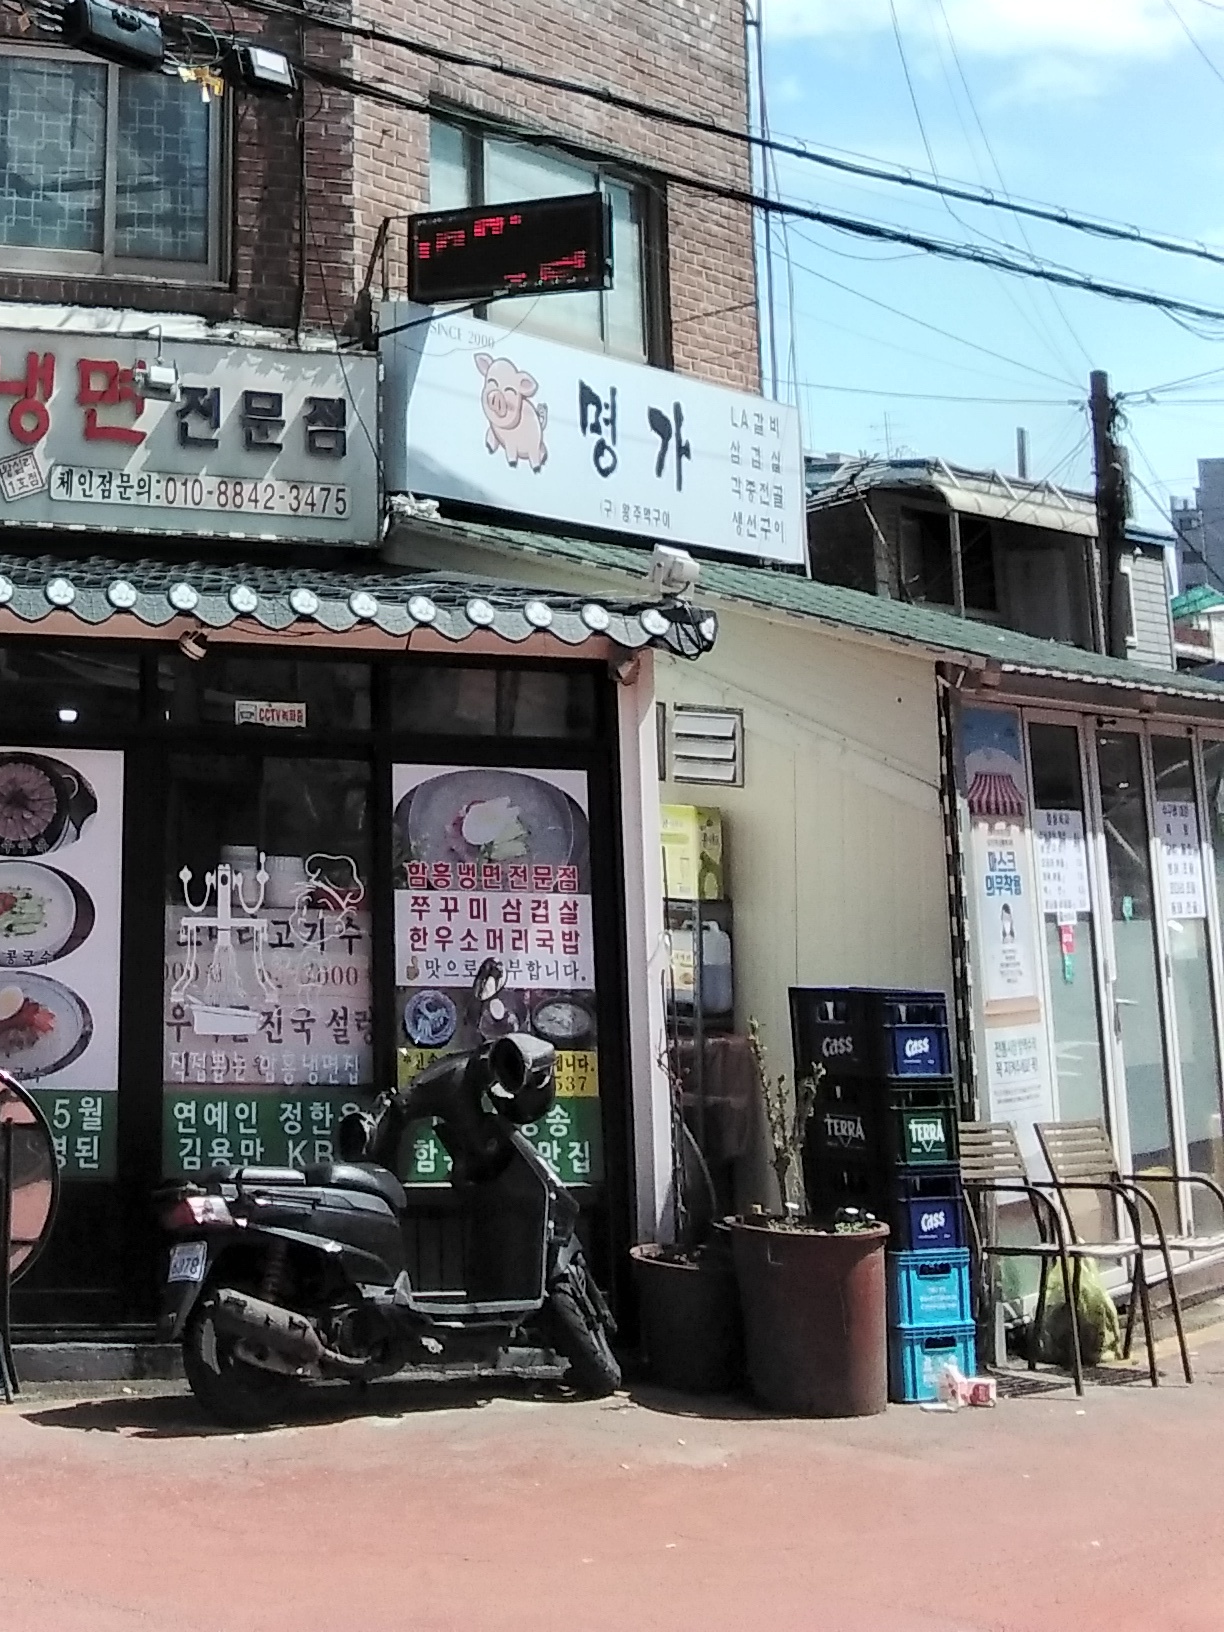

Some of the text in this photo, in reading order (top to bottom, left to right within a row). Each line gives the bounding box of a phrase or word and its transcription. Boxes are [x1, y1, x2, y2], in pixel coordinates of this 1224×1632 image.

[429, 321, 462, 342] SINCE
[176, 386, 347, 459] 전문점
[578, 379, 692, 492] 명가
[732, 511, 785, 544] 생선구이
[987, 850, 1017, 872] 마스크
[407, 862, 579, 893] 함흥냉면 전문점
[410, 895, 579, 925] 쭈꾸미 삼겹살
[425, 957, 587, 982] 맛으로 부합니다.
[821, 1035, 853, 1058] Cass
[904, 1036, 930, 1057] Cass
[173, 1100, 258, 1135] 연예인
[824, 1115, 865, 1141] TERRA
[908, 1118, 945, 1144] TERRA
[178, 1137, 265, 1171] 김용만
[920, 1210, 945, 1233] Cass
